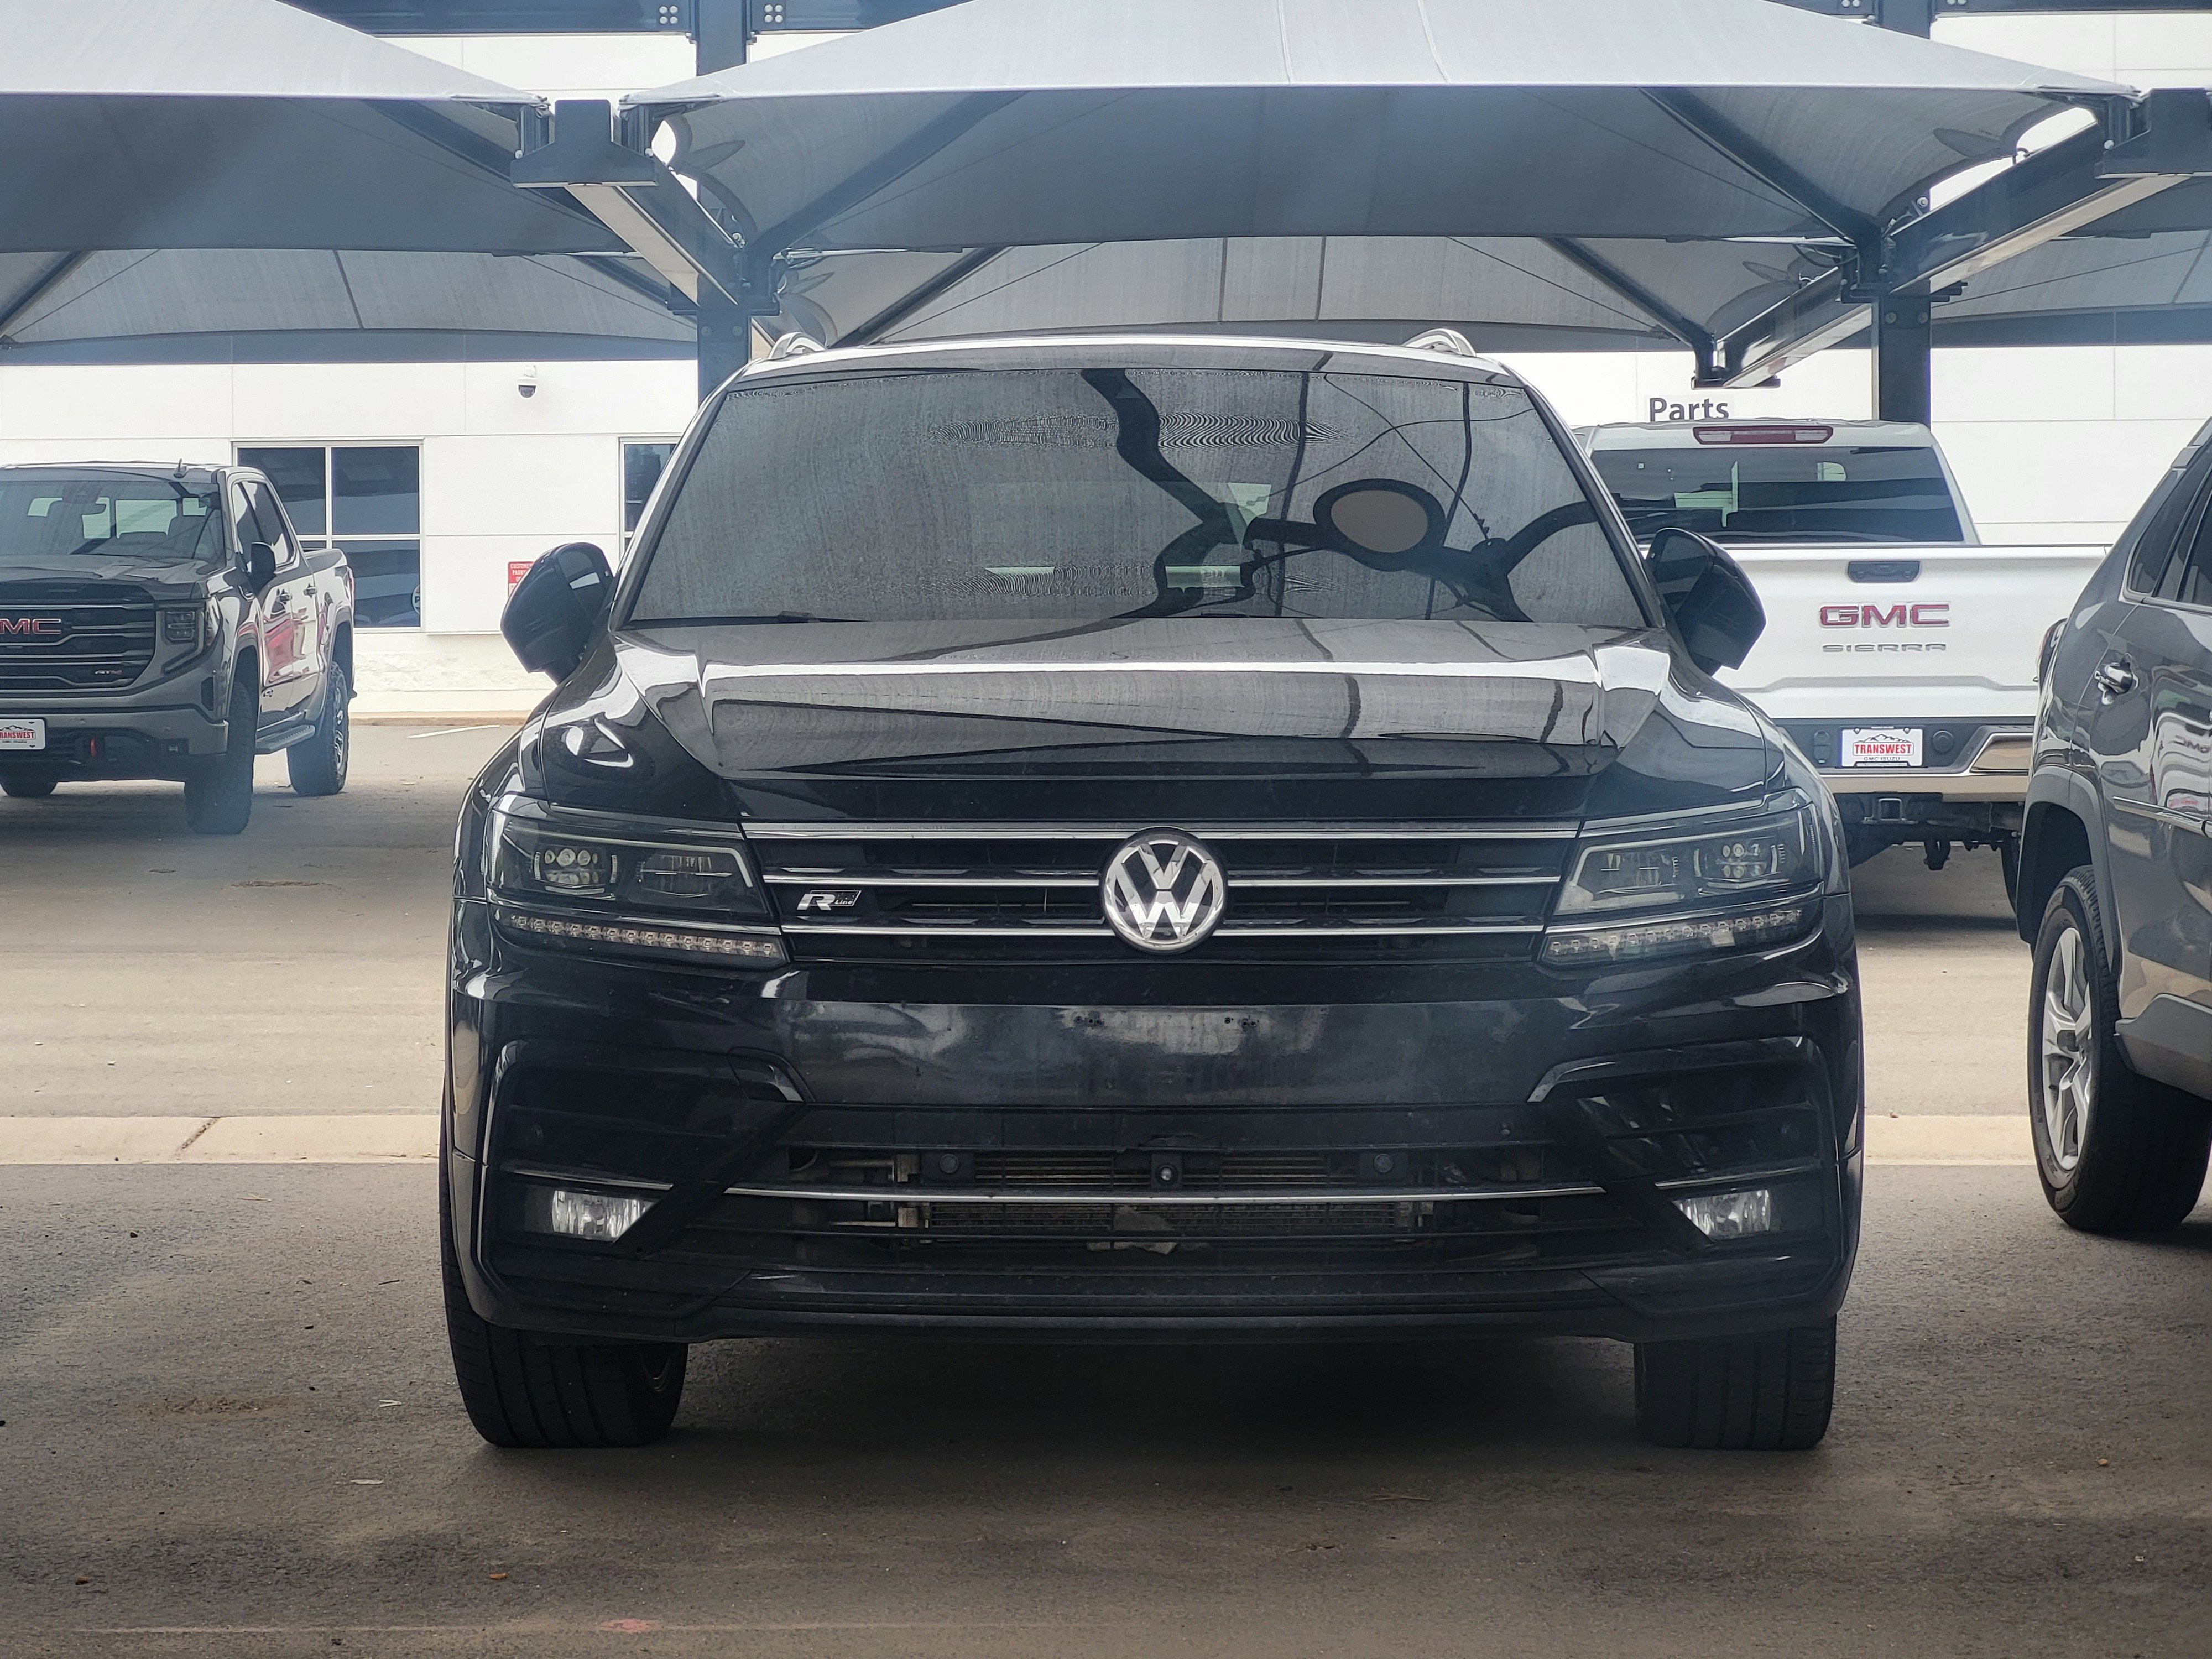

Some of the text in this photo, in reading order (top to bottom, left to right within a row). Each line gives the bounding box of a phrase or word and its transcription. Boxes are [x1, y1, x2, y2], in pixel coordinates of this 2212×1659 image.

[1650, 398, 1729, 422] Parts
[1820, 603, 1950, 628] GMC
[0, 618, 61, 635] MC
[1823, 644, 1947, 652] SIERRA
[1854, 744, 1912, 754] TRANSWEST
[796, 893, 836, 911] R
